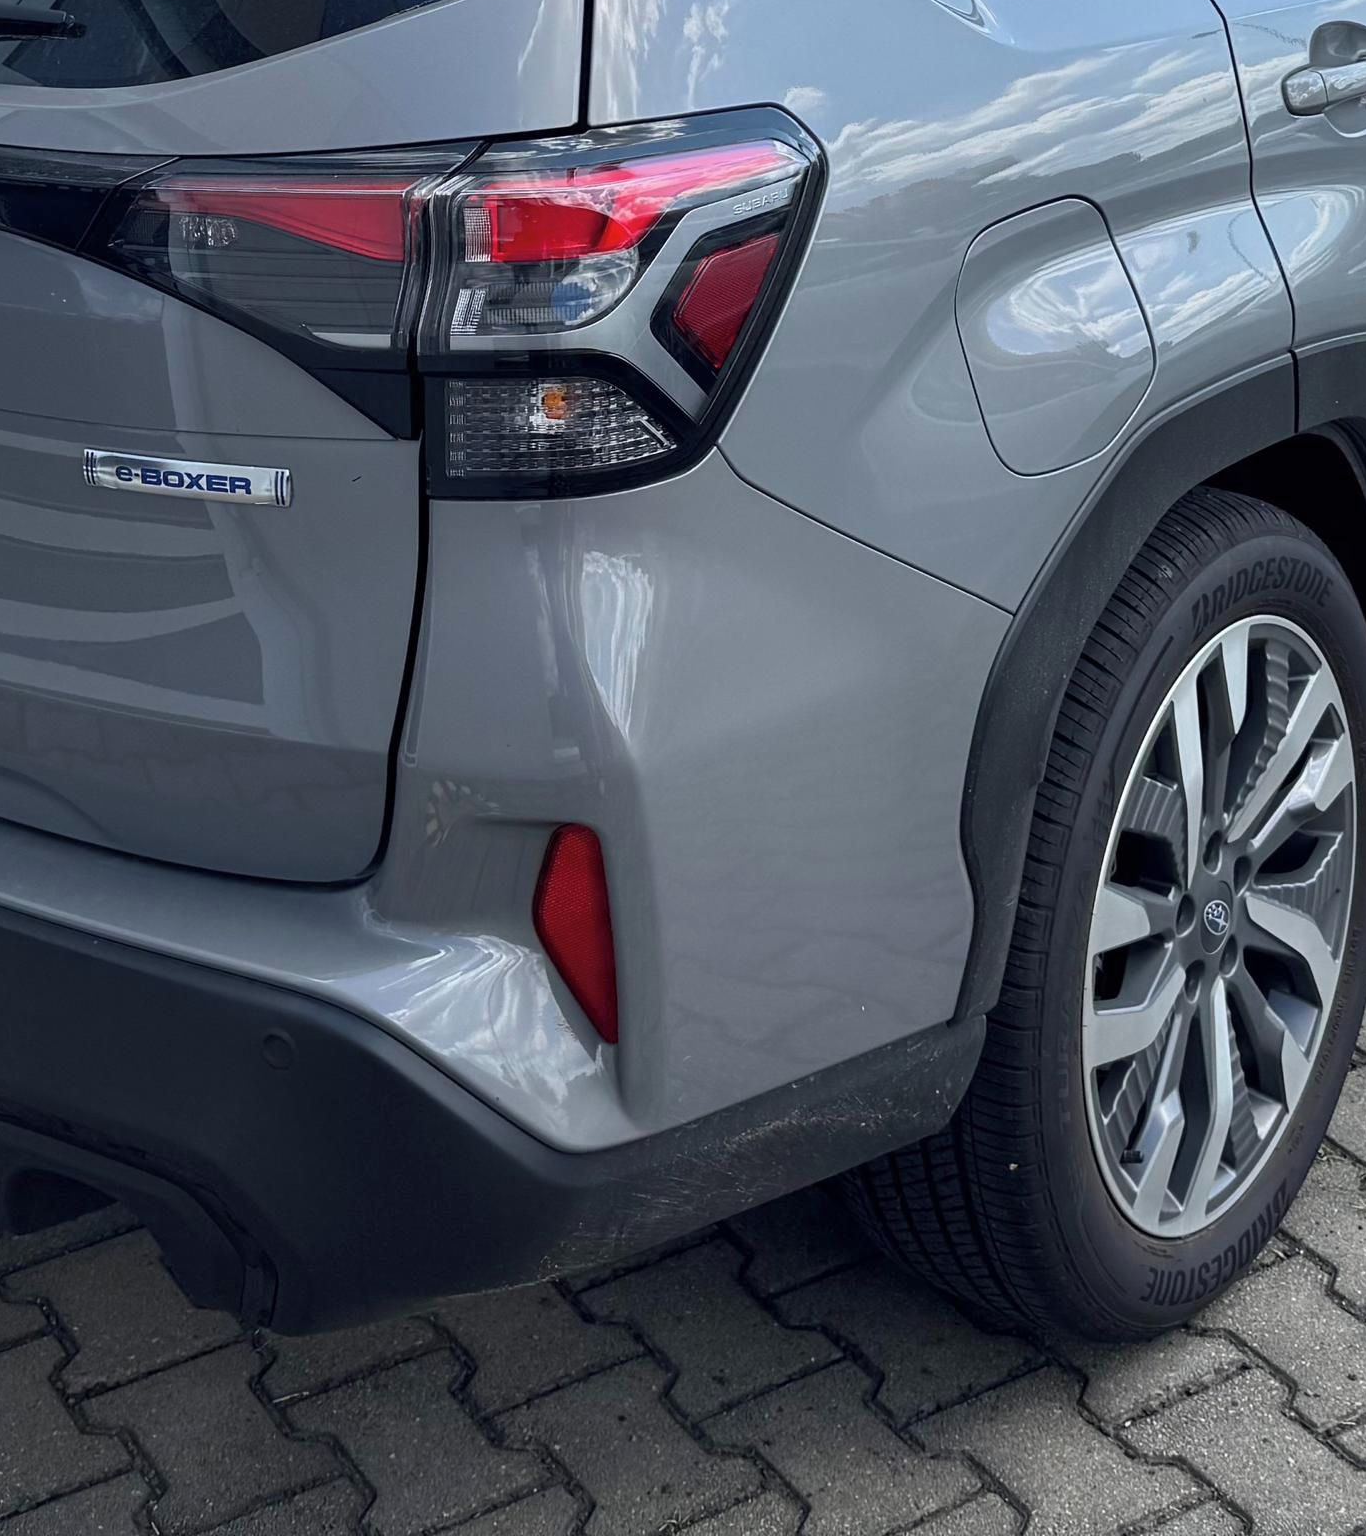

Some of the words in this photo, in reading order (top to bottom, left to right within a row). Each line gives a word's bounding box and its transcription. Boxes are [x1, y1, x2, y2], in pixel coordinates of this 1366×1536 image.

[732, 188, 788, 216] SUBARU
[115, 465, 252, 495] e-BOXER
[1191, 555, 1334, 642] BRIDGESTONE
[1138, 1177, 1290, 1306] BRIDGESTONE
